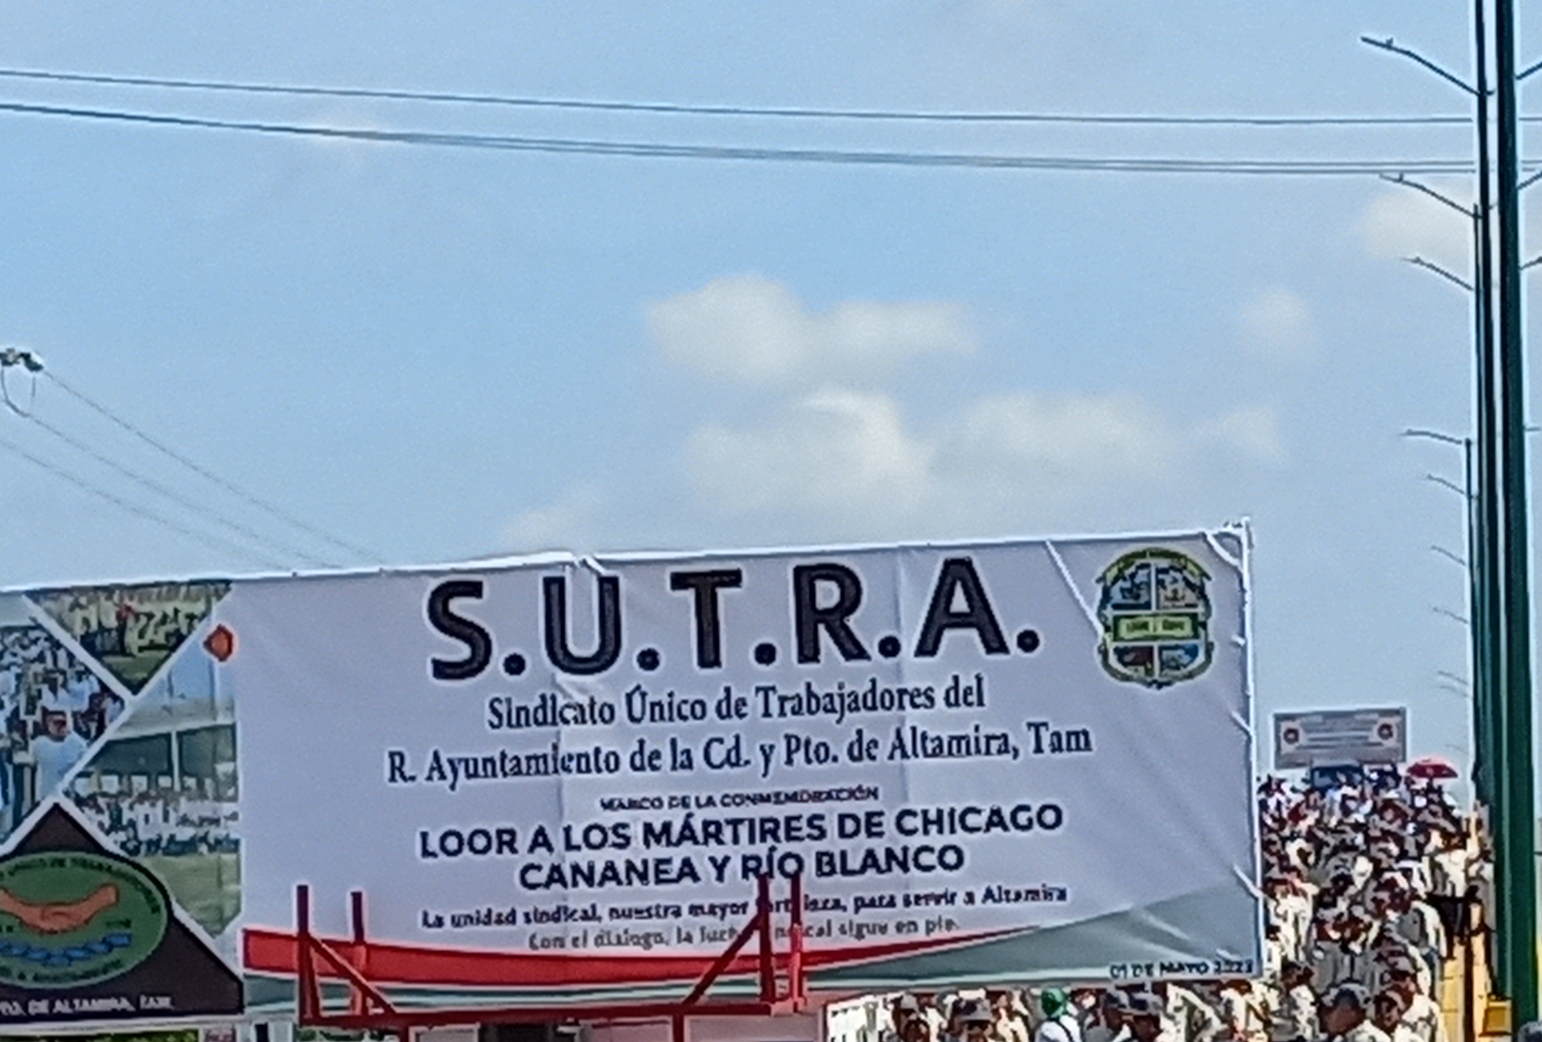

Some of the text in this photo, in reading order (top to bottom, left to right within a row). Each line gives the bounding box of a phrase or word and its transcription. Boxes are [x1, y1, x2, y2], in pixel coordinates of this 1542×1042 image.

[426, 556, 1041, 681] S.U.T.R.A.
[488, 673, 986, 730] Sindicato Único de Trabajadores del
[388, 721, 1094, 790] R. Ayuntamiento de la Cd. y Pto. de Altamira, Tam
[667, 795, 691, 810] DE
[694, 794, 718, 809] LA
[419, 803, 1063, 858] LOOR A LOS MÁRTIRES DE CHICAGO
[519, 844, 965, 890] CANANEA Y RÍO BLANCO
[421, 909, 445, 928] La
[451, 906, 517, 926] unidad
[523, 903, 603, 924] sindical,
[608, 901, 682, 921] nuestra
[688, 900, 749, 921] mayor
[853, 894, 897, 915] para
[903, 888, 958, 909] servir
[963, 892, 976, 906] a
[981, 883, 1068, 904] Altamira
[699, 925, 747, 943] luch
